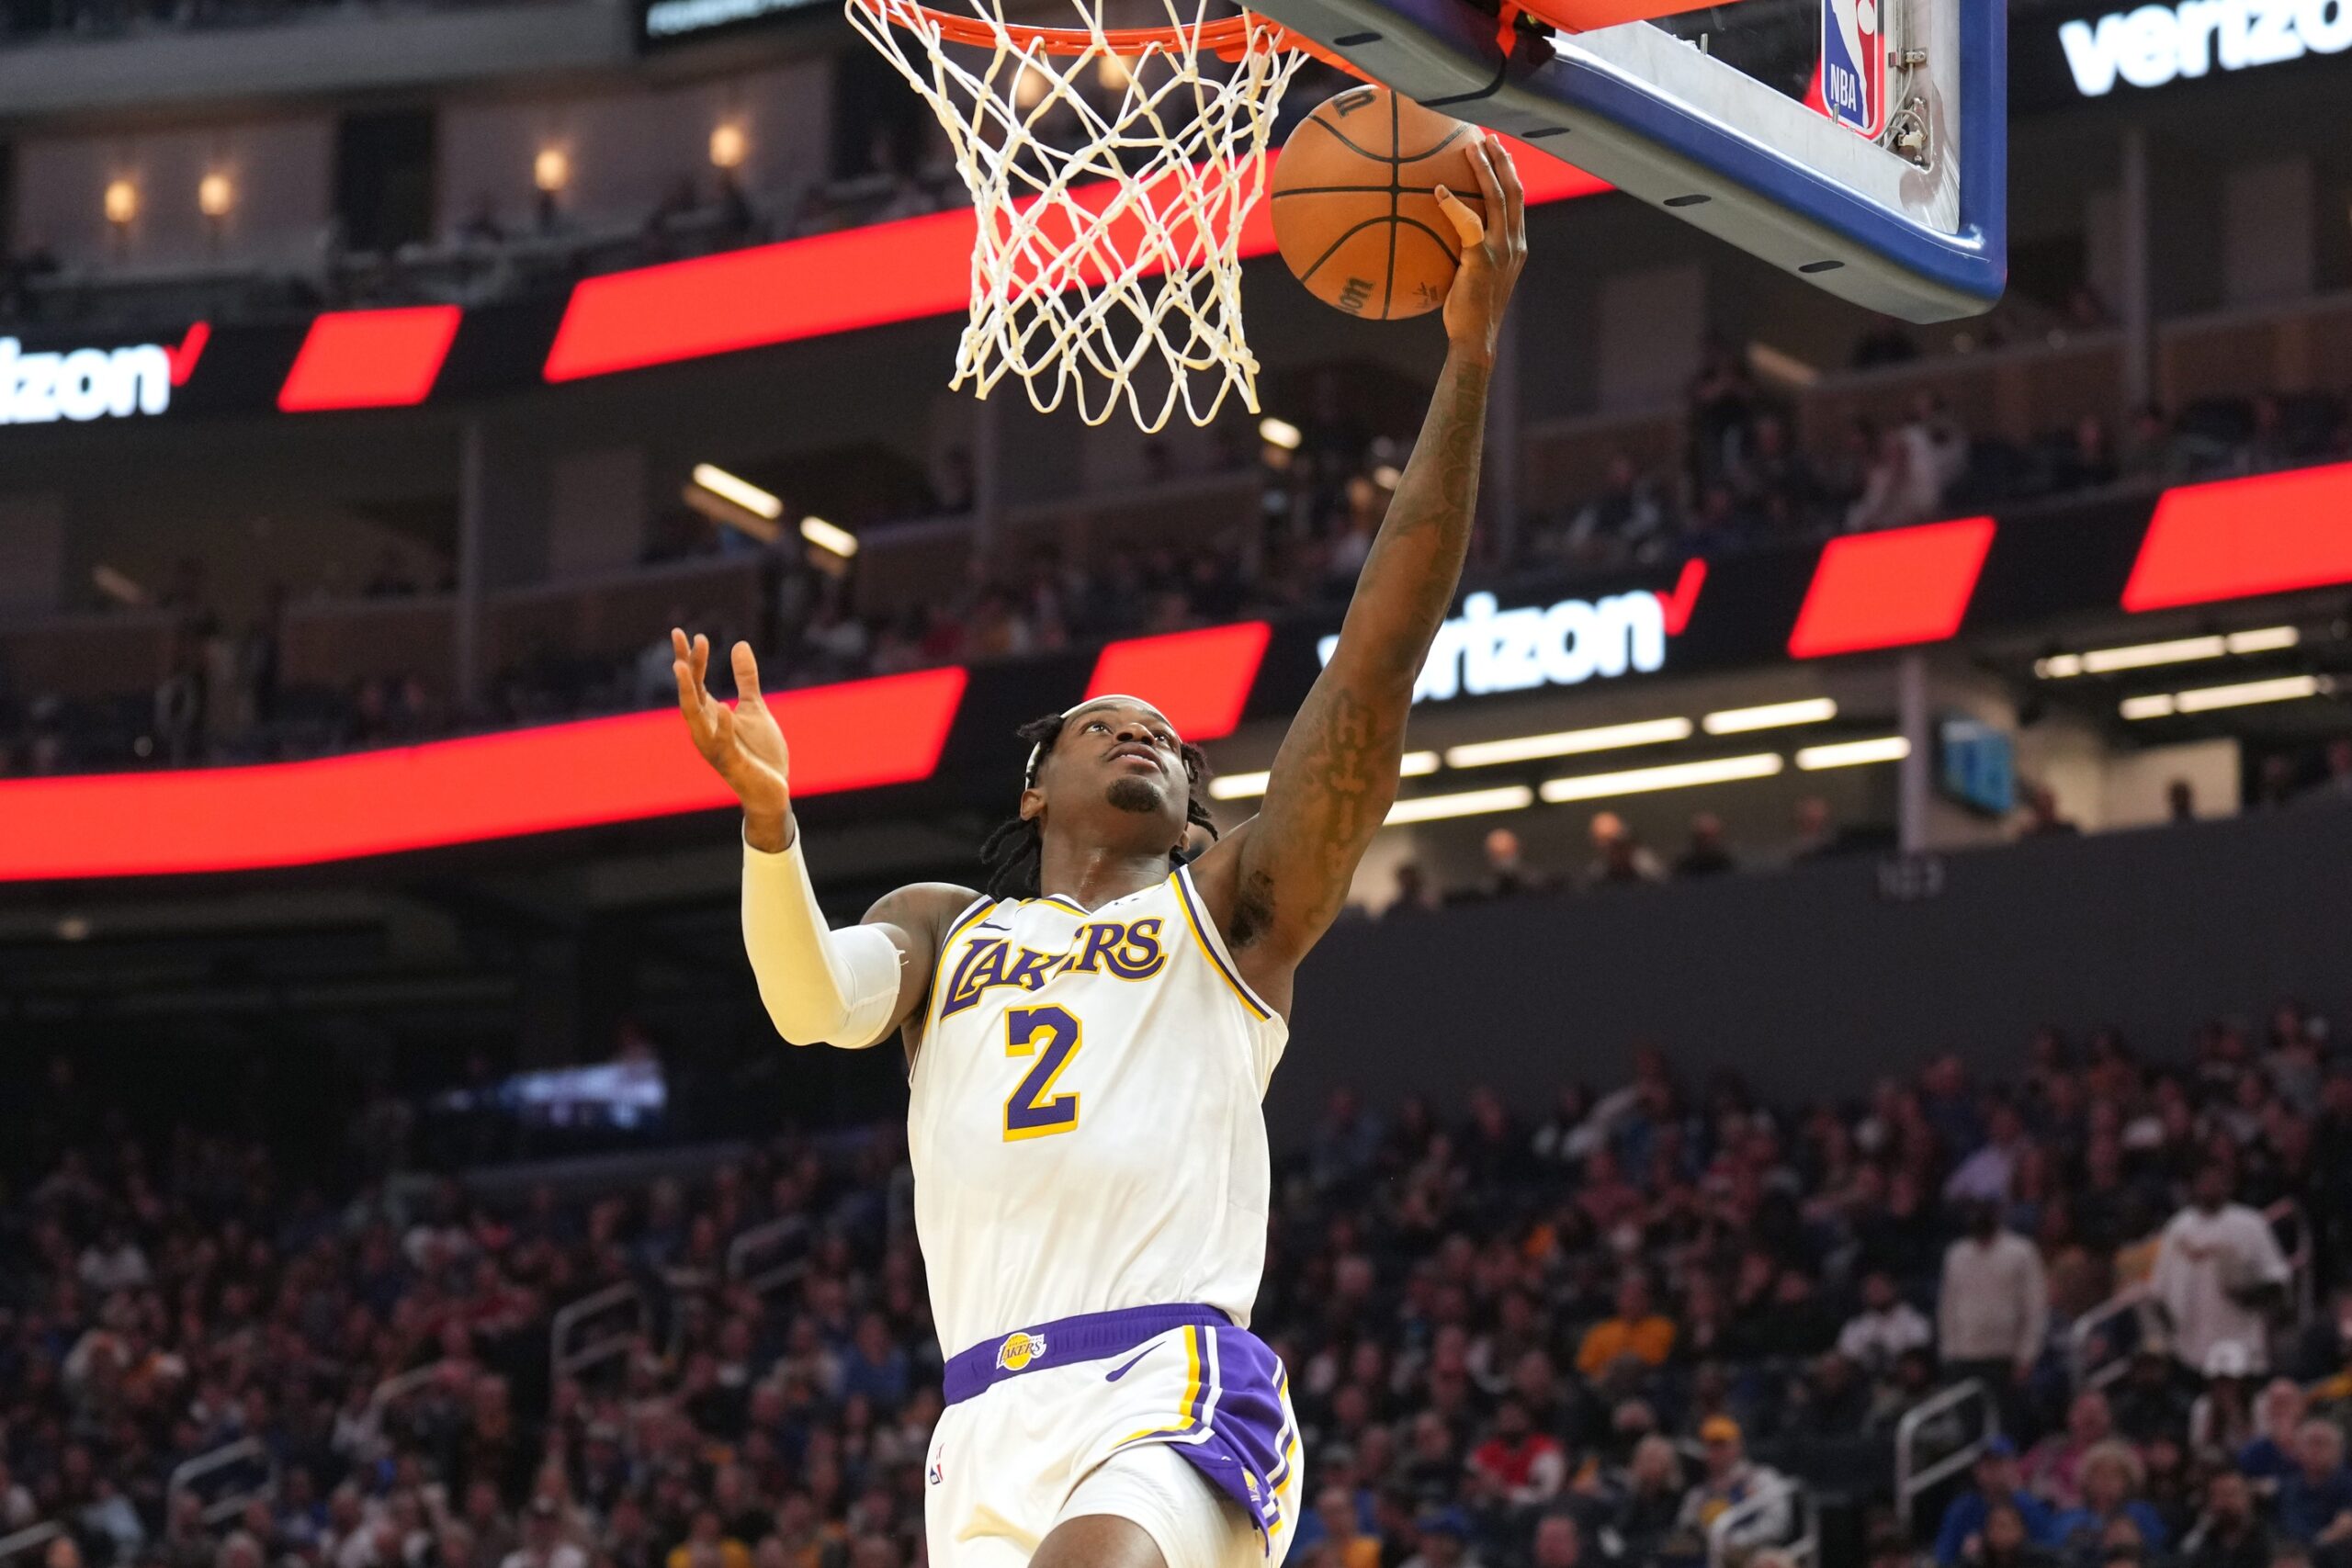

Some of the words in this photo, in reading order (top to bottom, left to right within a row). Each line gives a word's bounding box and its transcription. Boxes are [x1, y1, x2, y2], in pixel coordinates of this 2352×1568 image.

[1830, 62, 1857, 112] NBA
[1317, 591, 1666, 705] rizon
[1002, 1002, 1082, 1143] 2
[999, 1340, 1045, 1366] LAKERS
